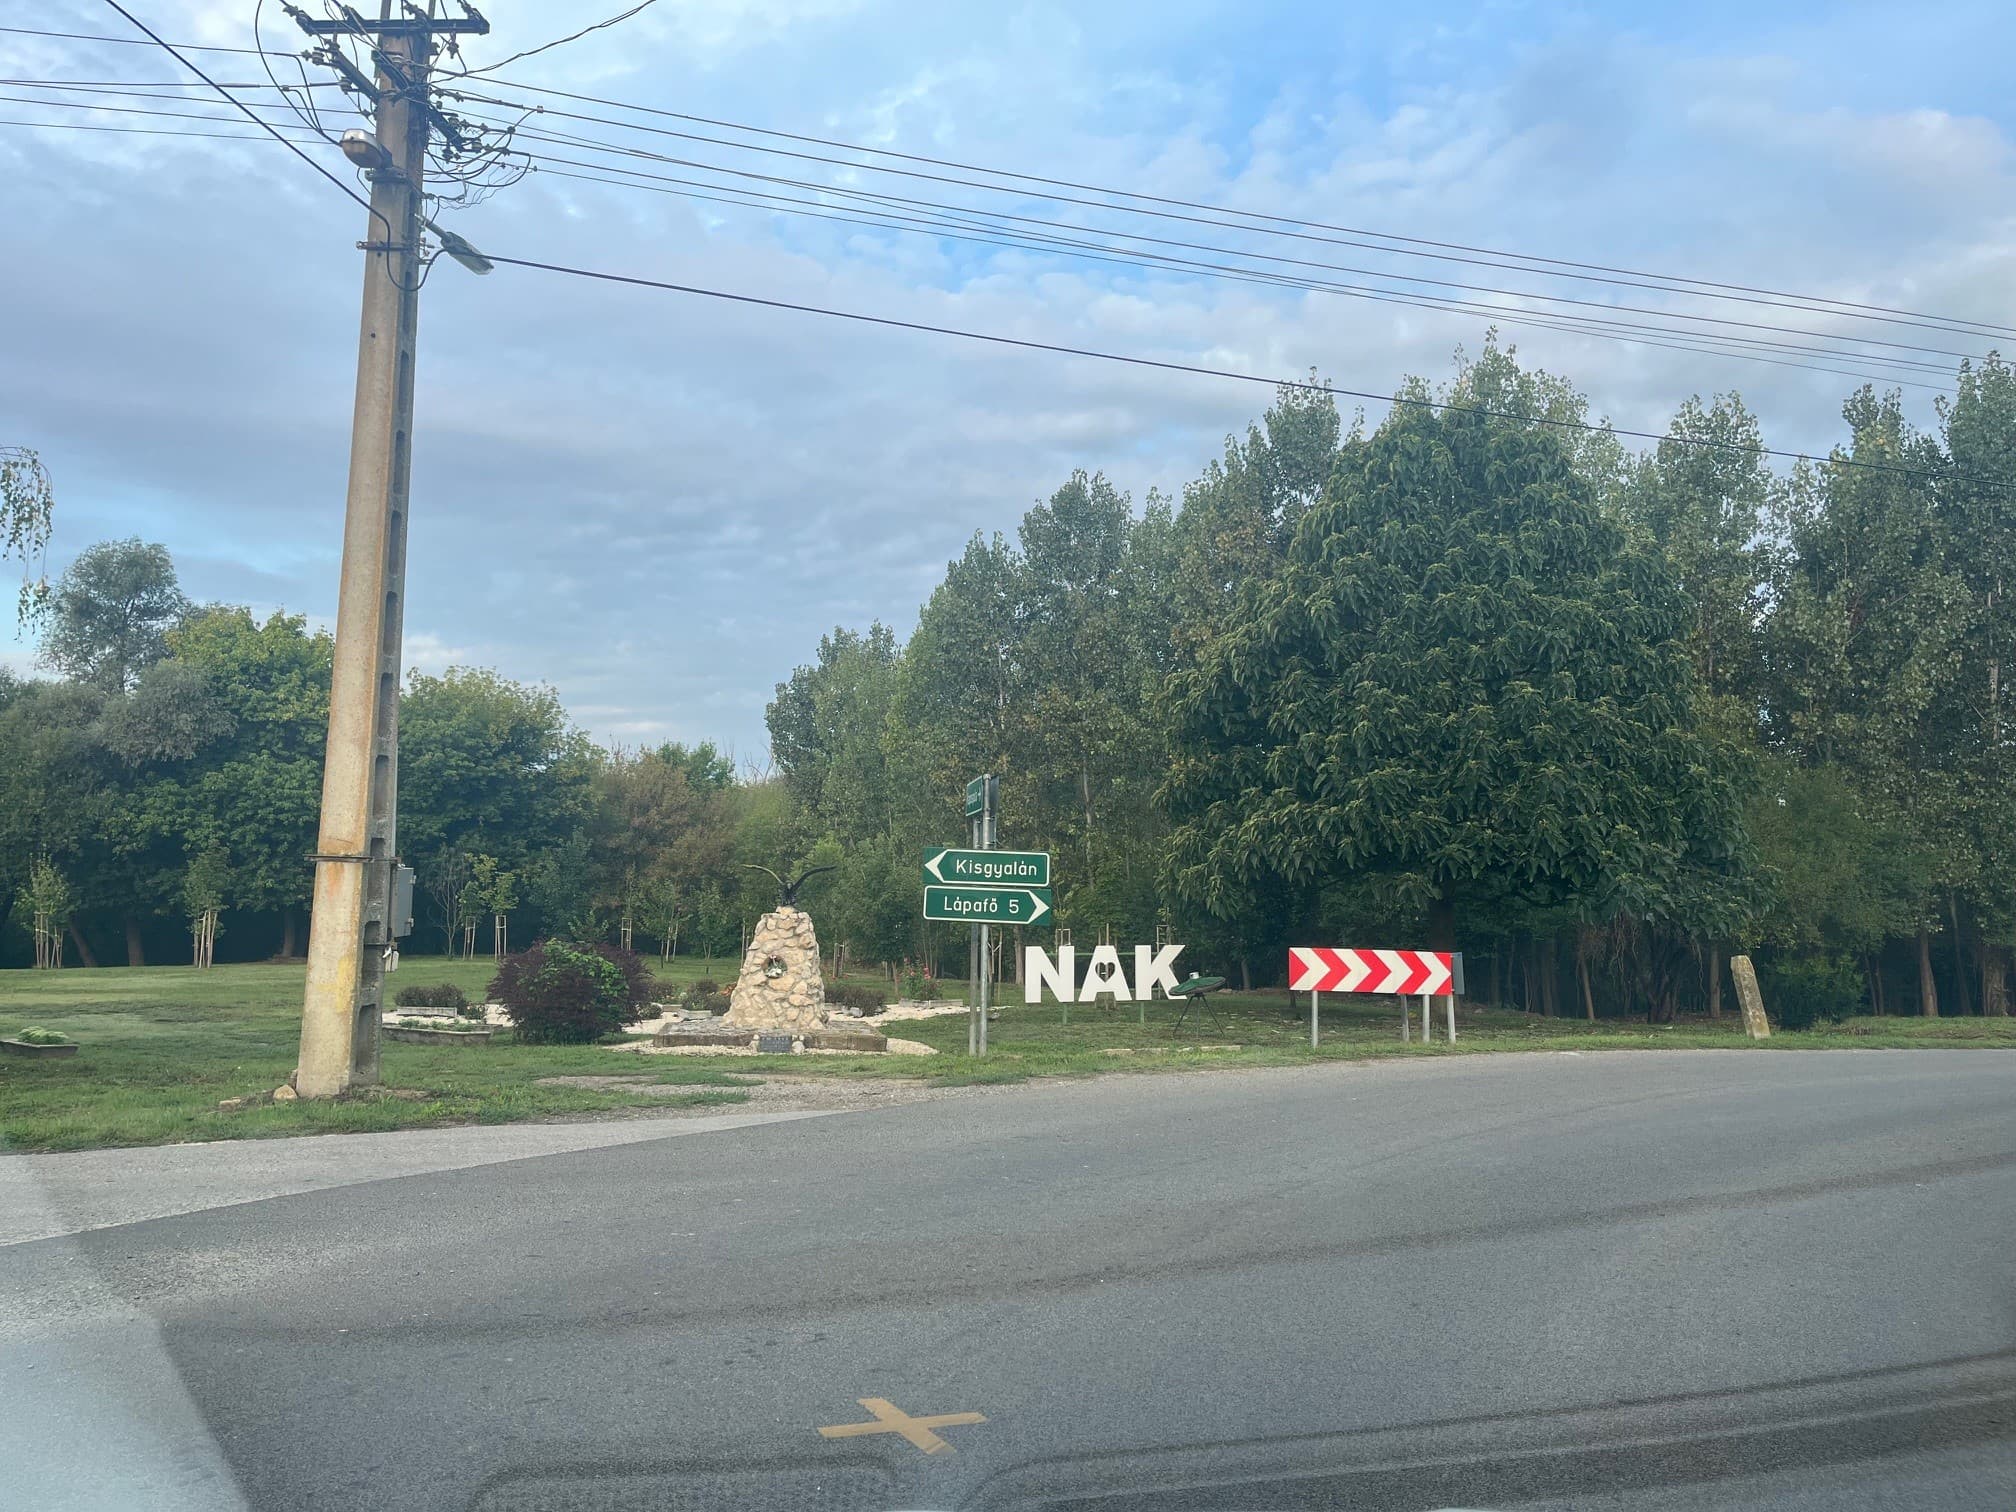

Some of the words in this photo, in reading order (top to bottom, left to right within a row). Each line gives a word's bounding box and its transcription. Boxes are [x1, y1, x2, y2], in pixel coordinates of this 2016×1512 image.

[956, 859, 1037, 878] Kisgyalán
[944, 896, 998, 915] Lápafő
[1008, 899, 1020, 914] 5
[1025, 944, 1188, 1003] NAK
